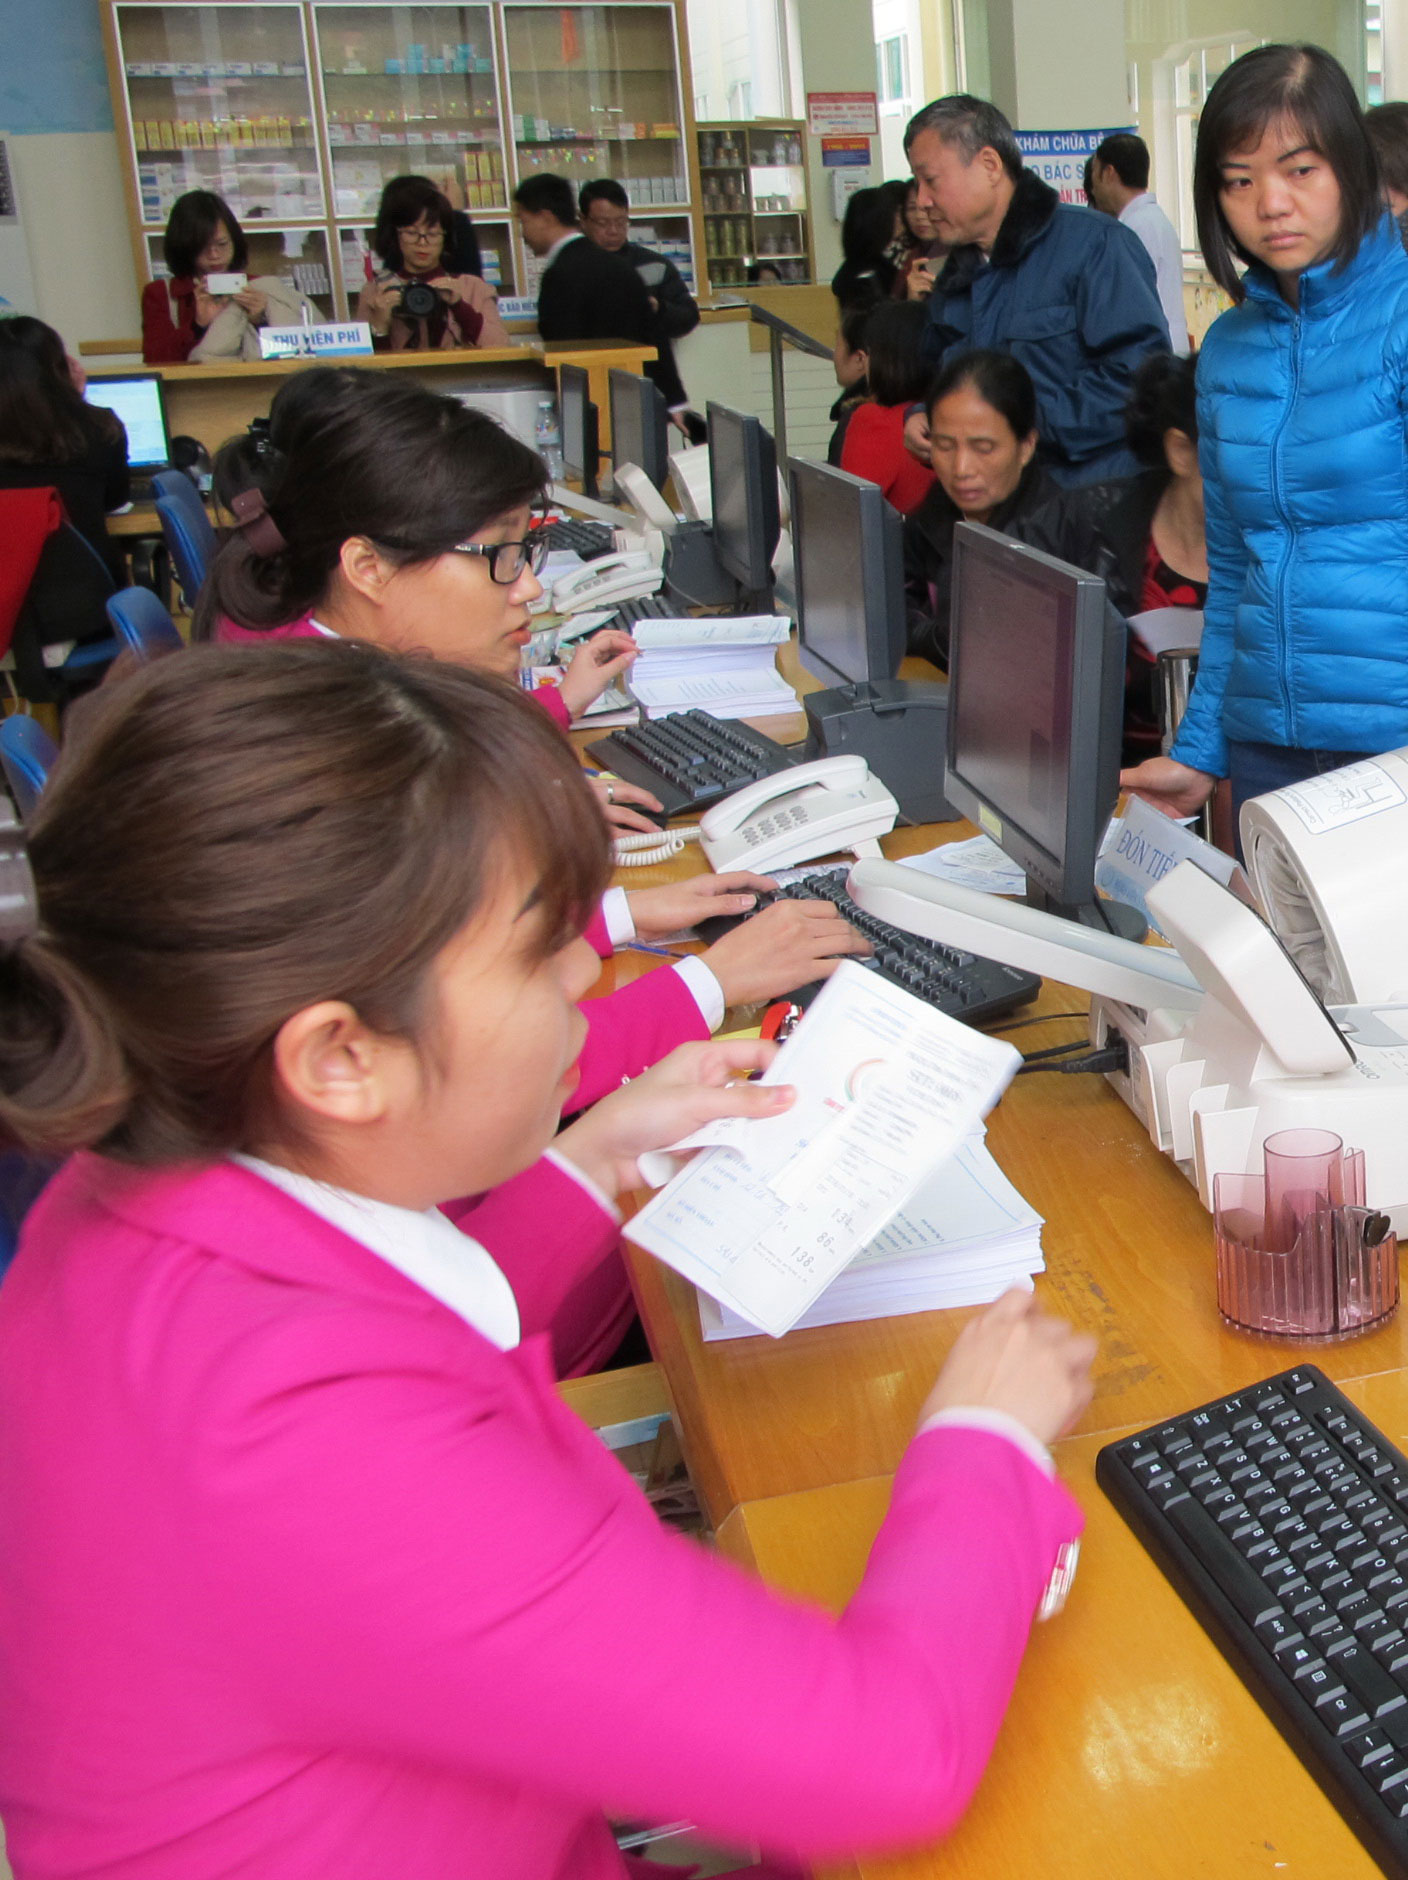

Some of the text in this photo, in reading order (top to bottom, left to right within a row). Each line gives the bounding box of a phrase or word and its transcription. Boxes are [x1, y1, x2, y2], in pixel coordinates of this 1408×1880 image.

[1015, 133, 1050, 152] KHÁM
[1053, 132, 1086, 152] CHỮA
[1044, 160, 1072, 180] BÁC
[337, 328, 361, 343] PHÍ
[1116, 829, 1179, 881] ĐÓN TIẾ
[816, 1232, 835, 1248] 86
[790, 1246, 814, 1268] 138
